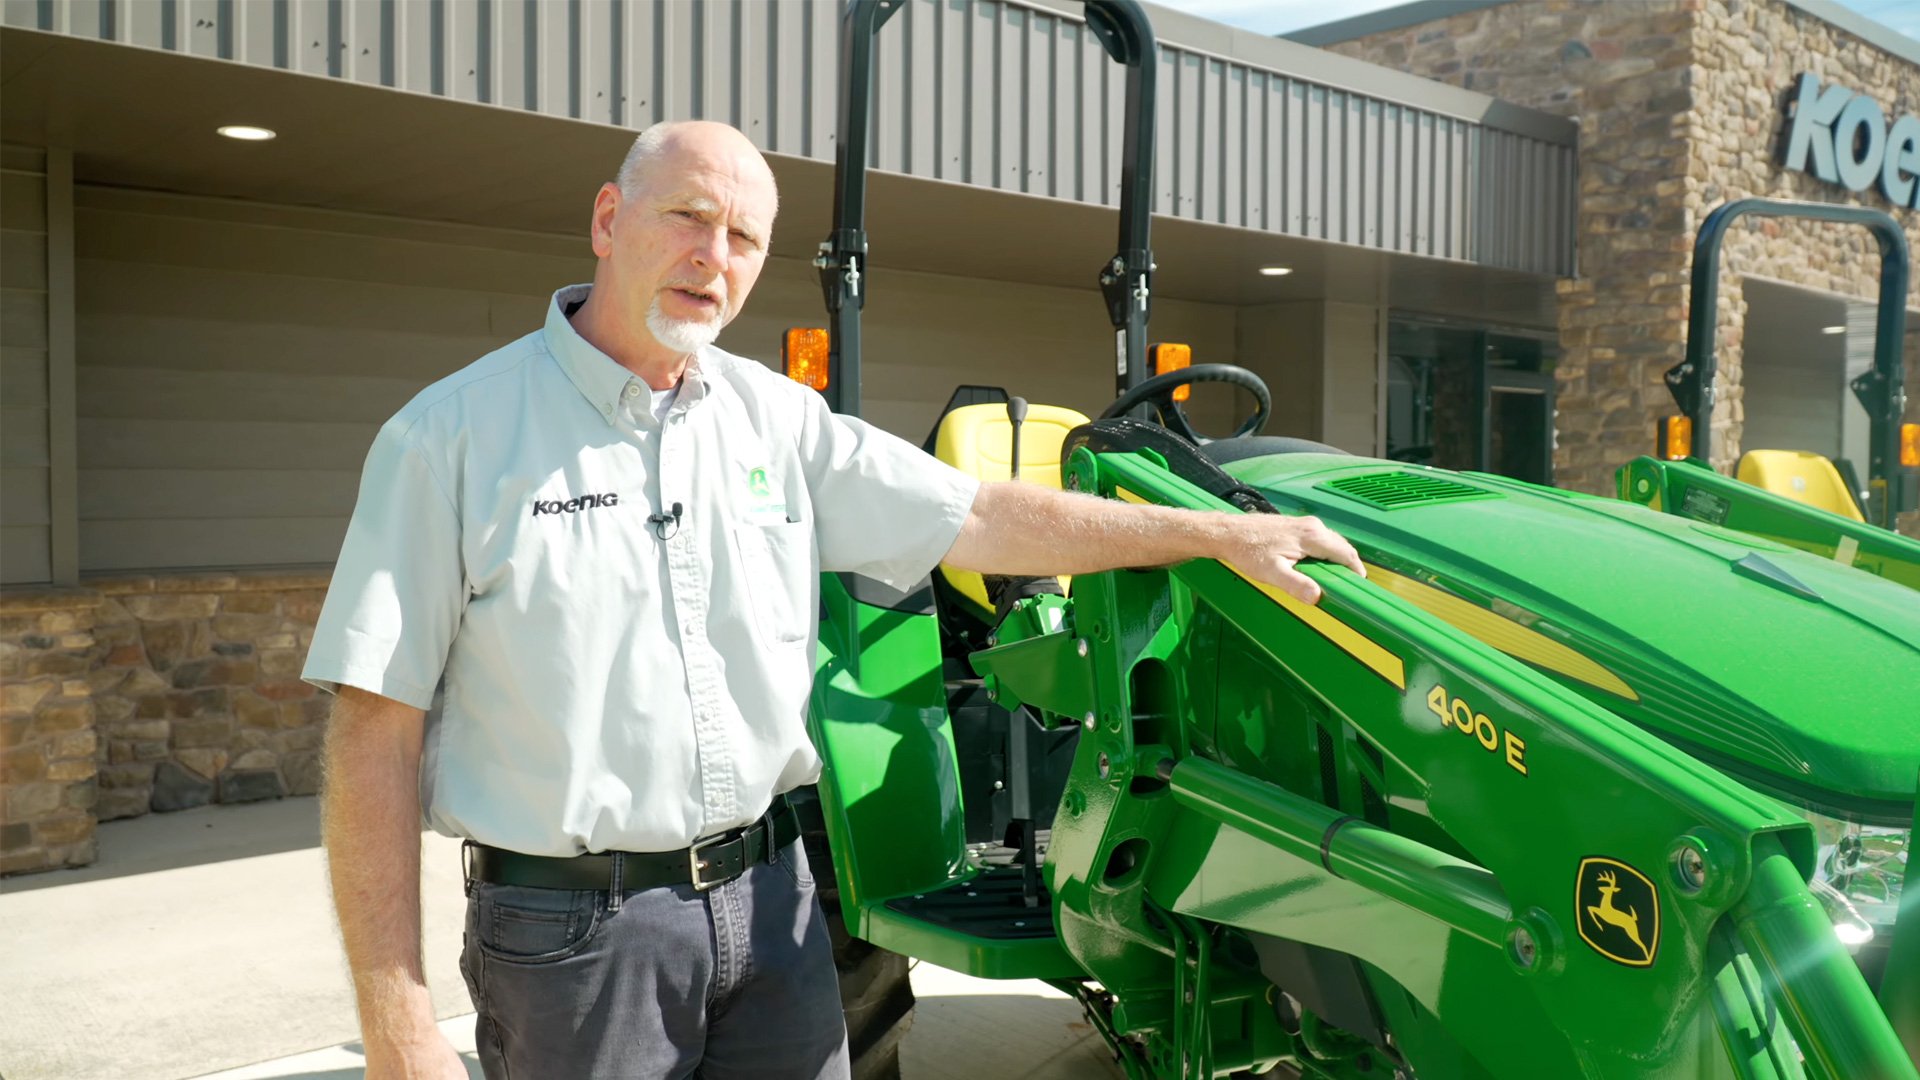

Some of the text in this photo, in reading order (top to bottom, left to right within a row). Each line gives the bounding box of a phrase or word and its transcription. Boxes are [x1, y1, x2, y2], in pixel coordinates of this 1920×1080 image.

[1786, 71, 1920, 210] KOe
[1427, 683, 1528, 777] 400 E
